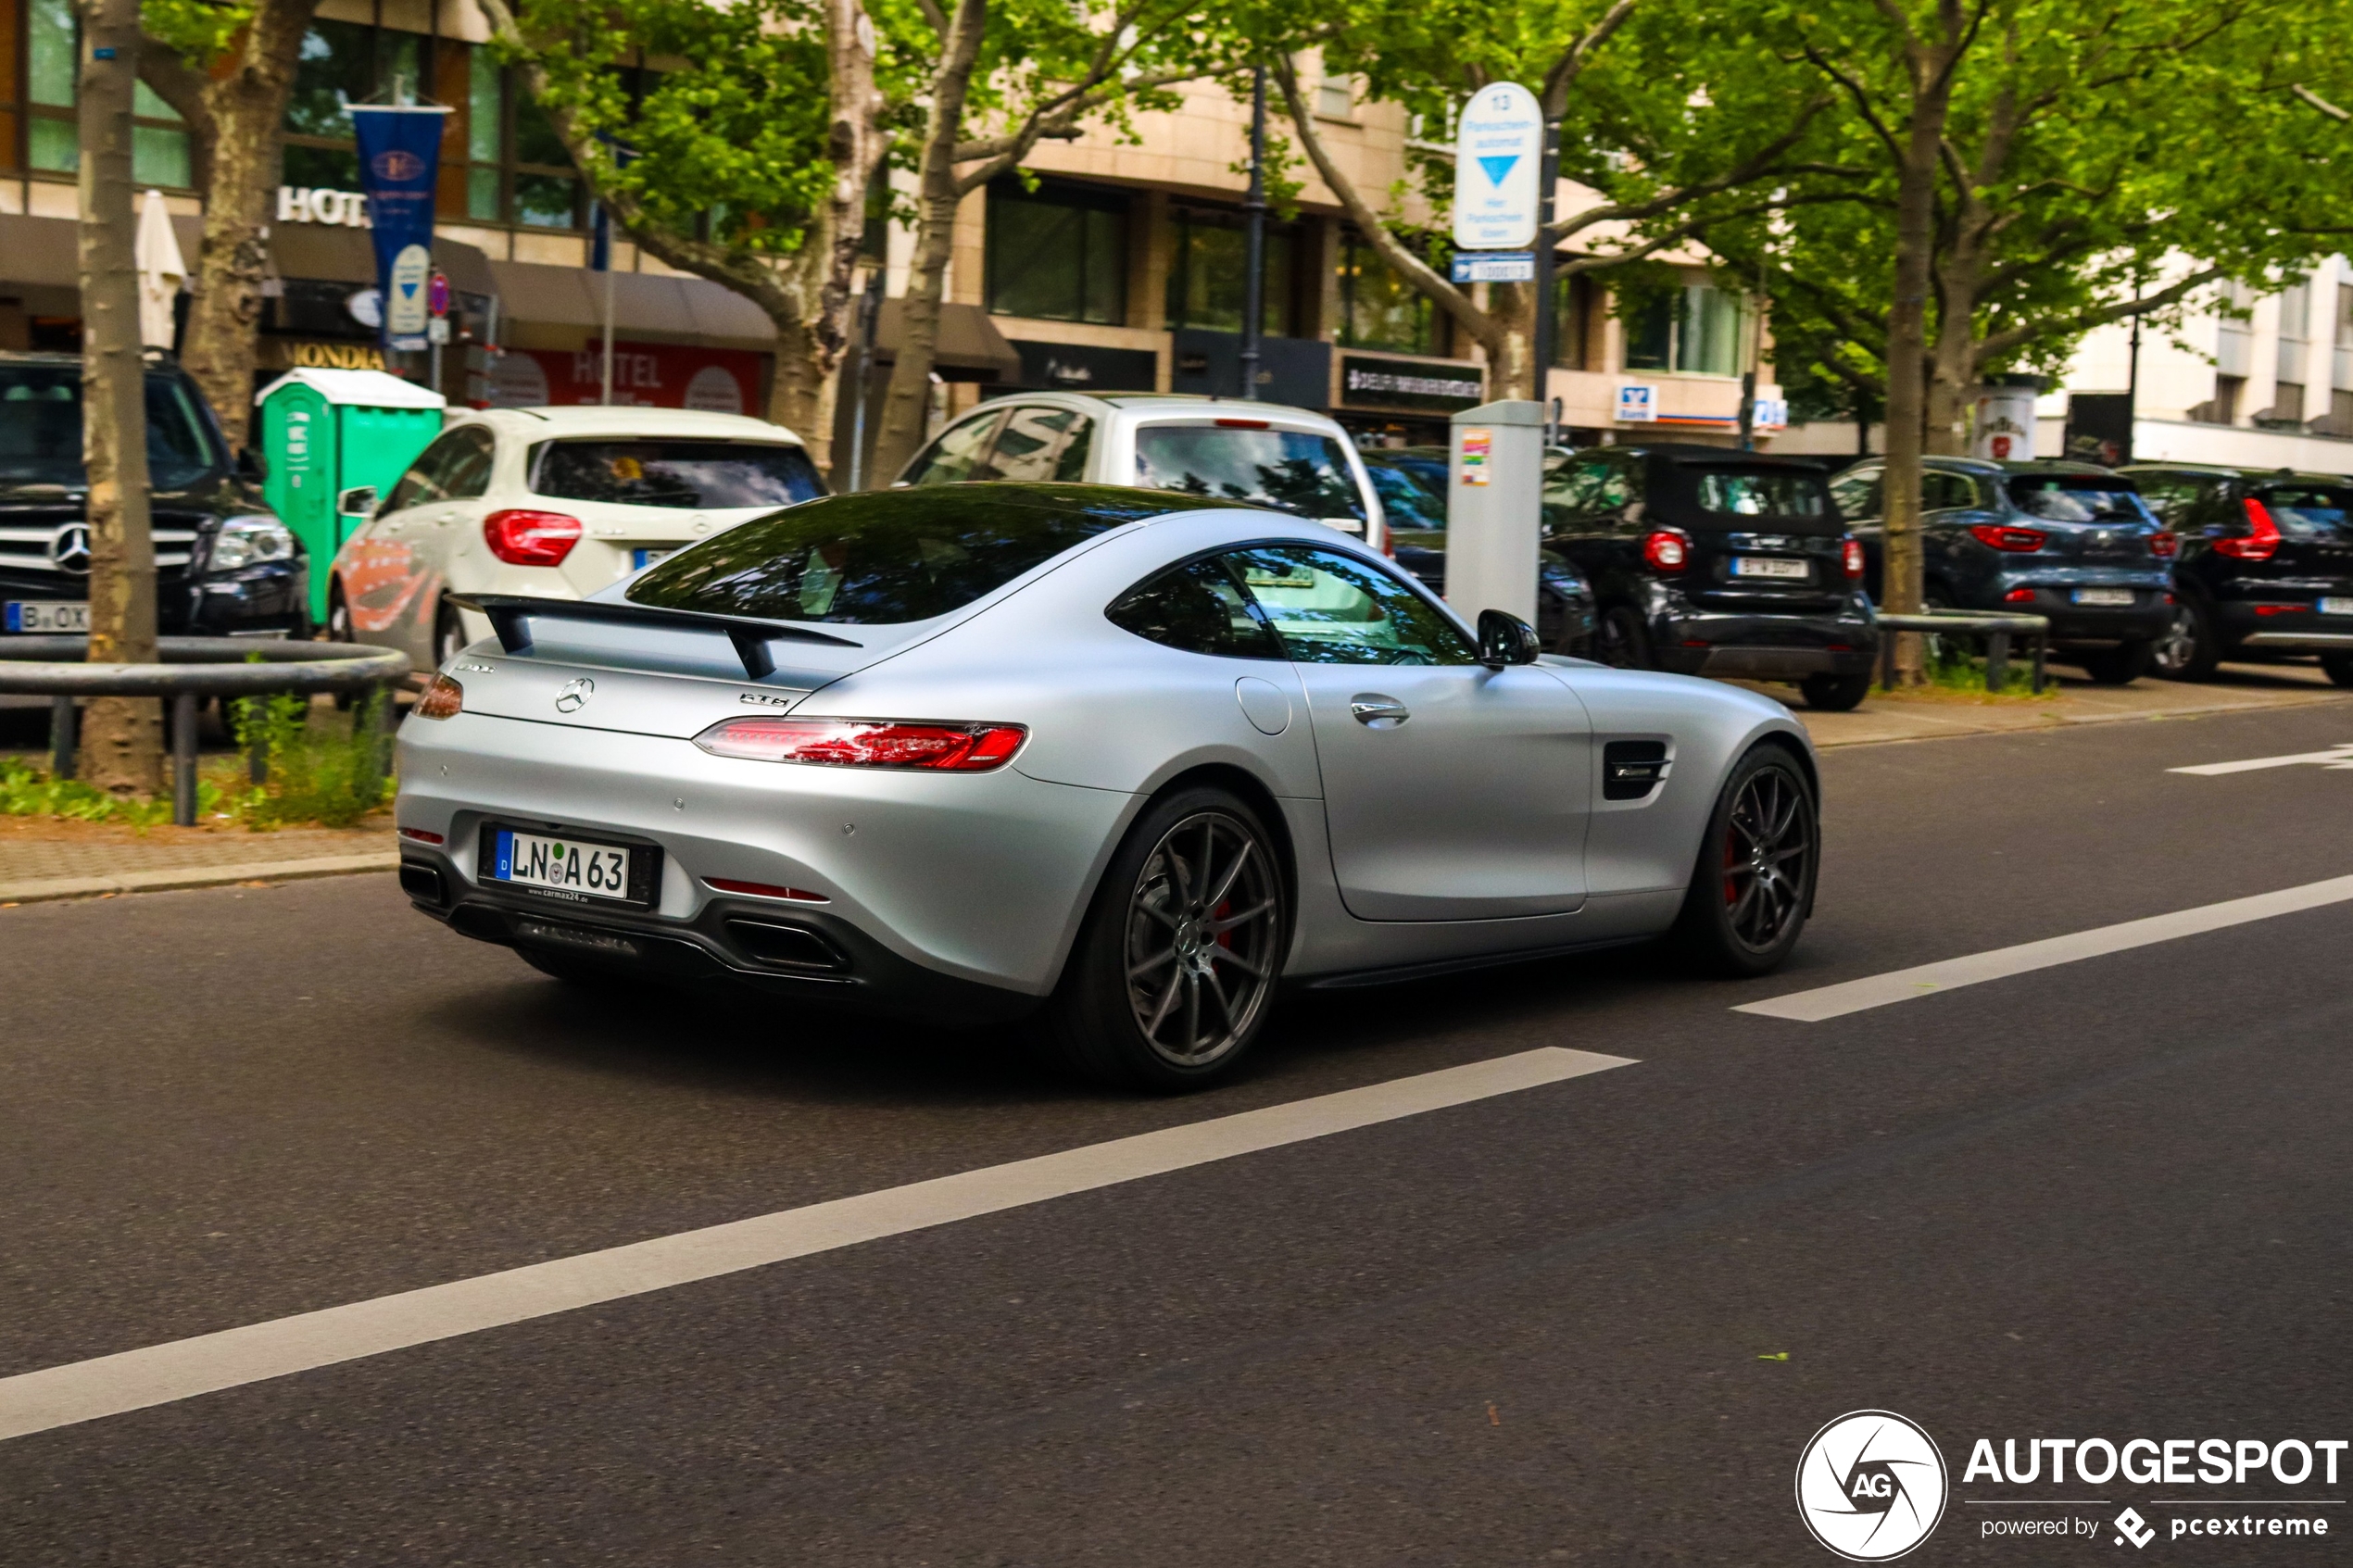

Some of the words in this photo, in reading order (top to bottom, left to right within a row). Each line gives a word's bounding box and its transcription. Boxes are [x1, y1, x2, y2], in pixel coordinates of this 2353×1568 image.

[1491, 94, 1511, 110] 13
[276, 186, 373, 229] HOT
[23, 606, 38, 628] B
[512, 839, 548, 881] LN
[528, 888, 589, 904] www.carmax24.de
